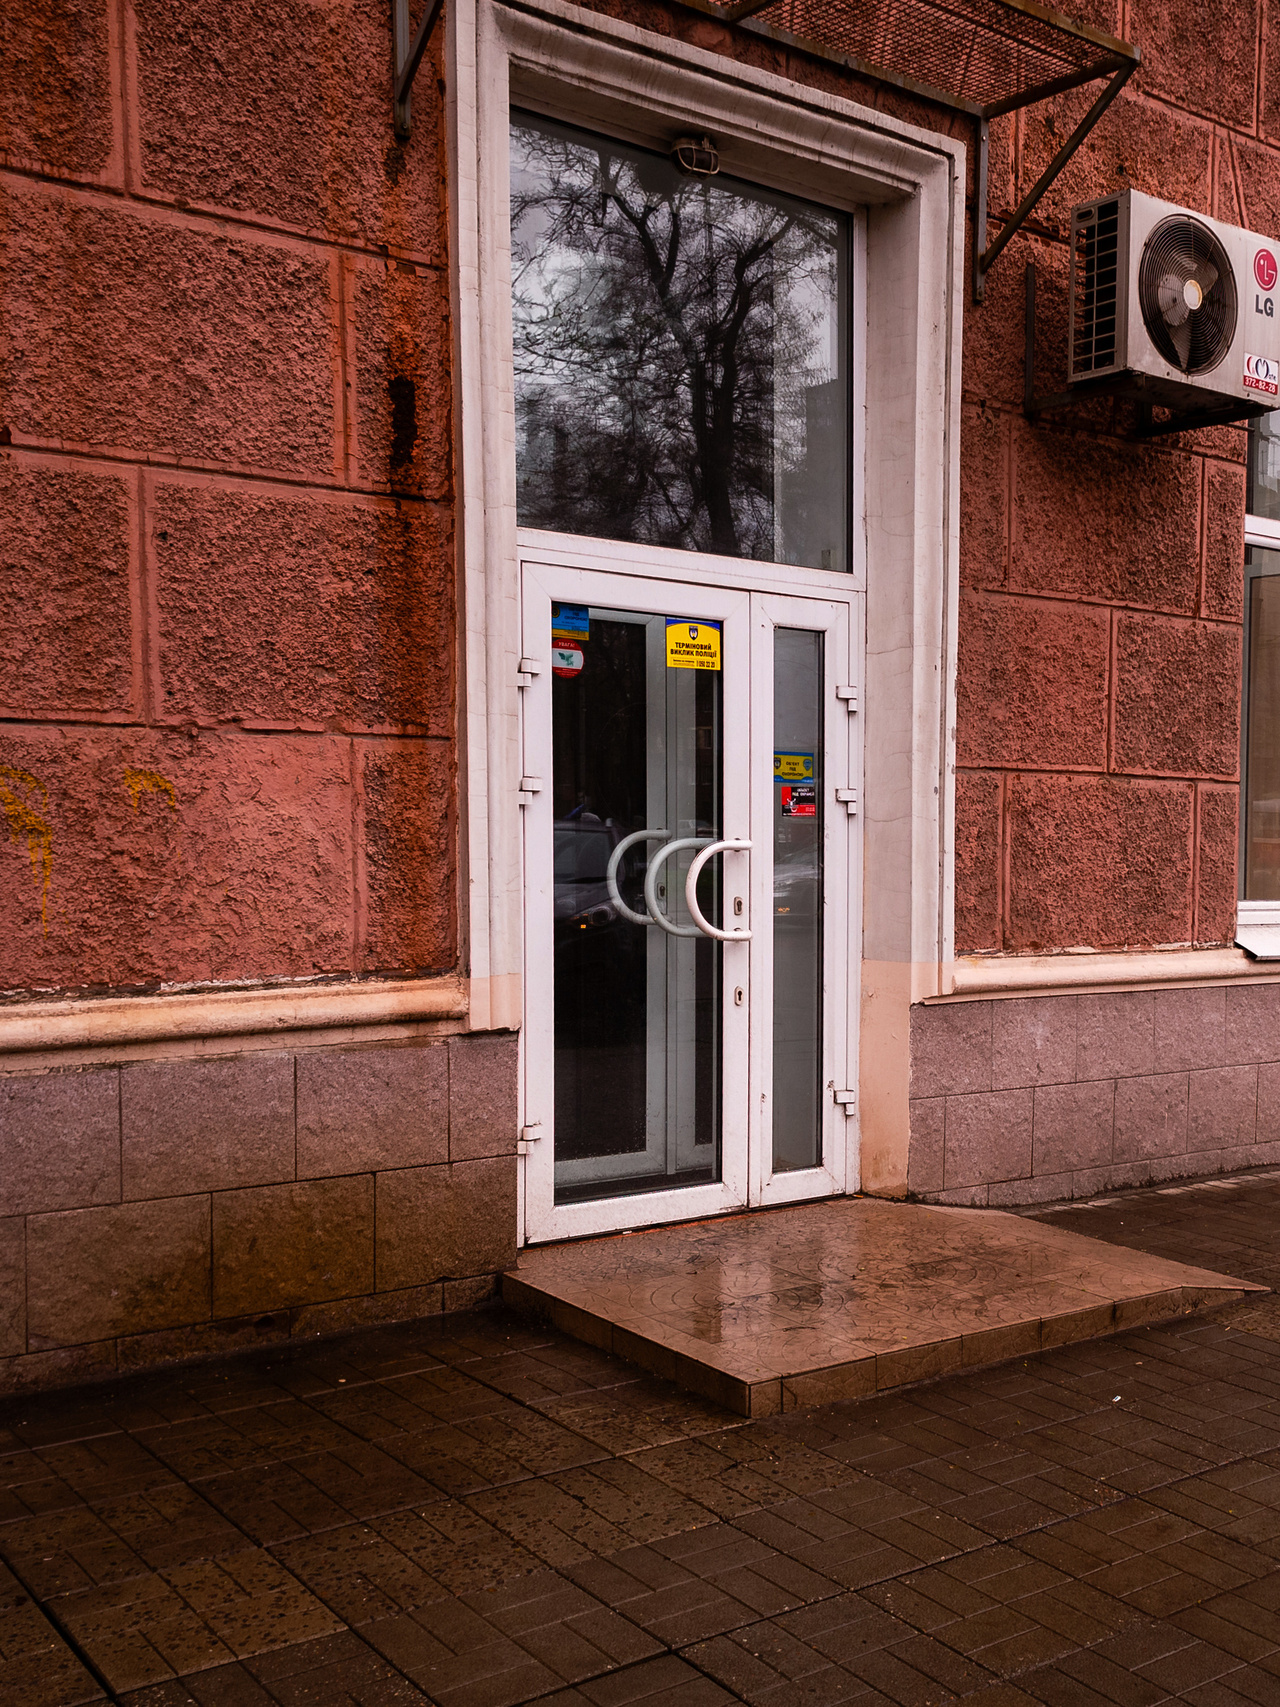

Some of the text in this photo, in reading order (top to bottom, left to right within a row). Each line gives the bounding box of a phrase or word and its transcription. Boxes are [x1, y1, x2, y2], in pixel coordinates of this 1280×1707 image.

[1255, 294, 1274, 318] LG
[1244, 376, 1276, 393] 372-82-28
[675, 642, 712, 650] ТЕРМІНОВИЙ
[695, 650, 717, 658] ПОЛІЦІЇ
